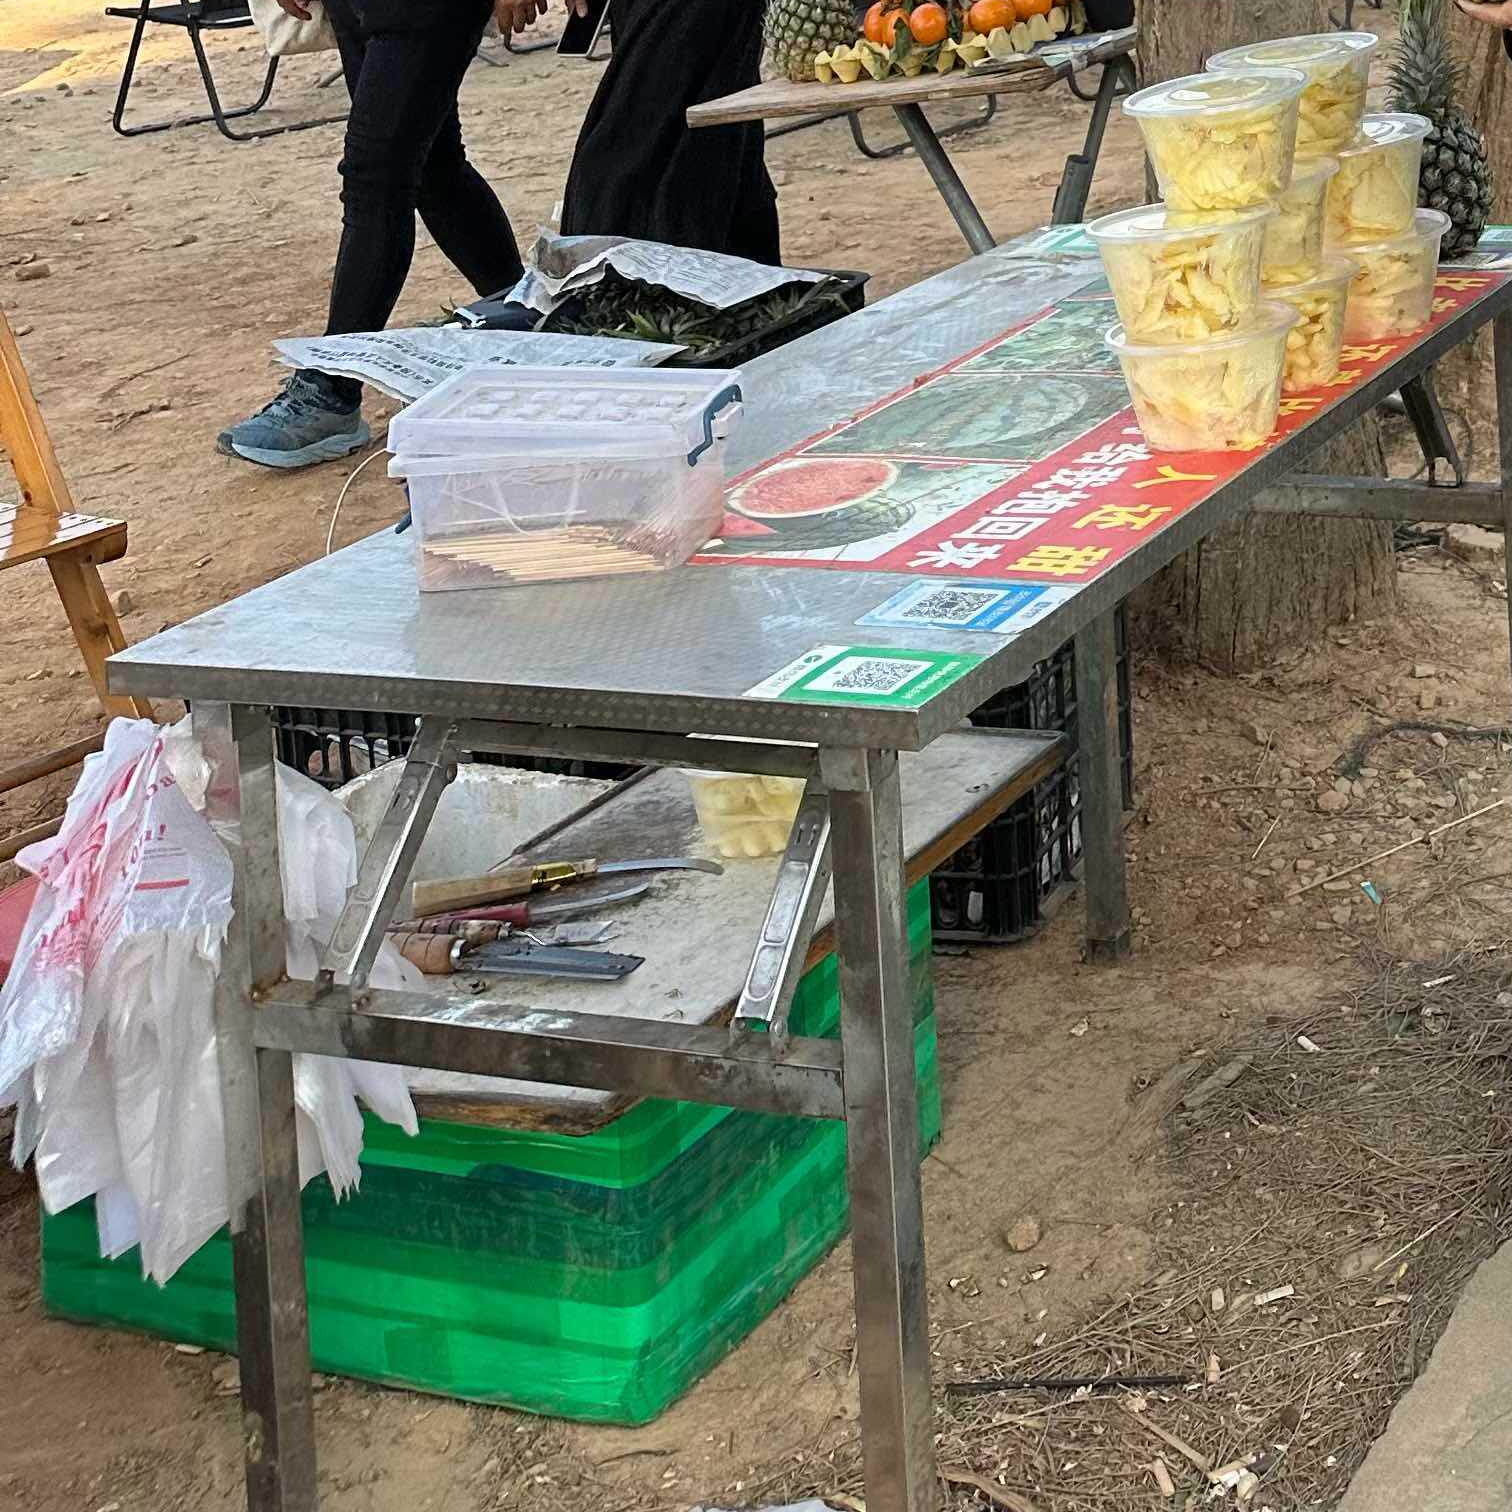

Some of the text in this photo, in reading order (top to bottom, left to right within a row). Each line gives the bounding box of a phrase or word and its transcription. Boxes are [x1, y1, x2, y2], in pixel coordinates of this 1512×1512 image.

[907, 426, 1153, 569] 给我抱回来
